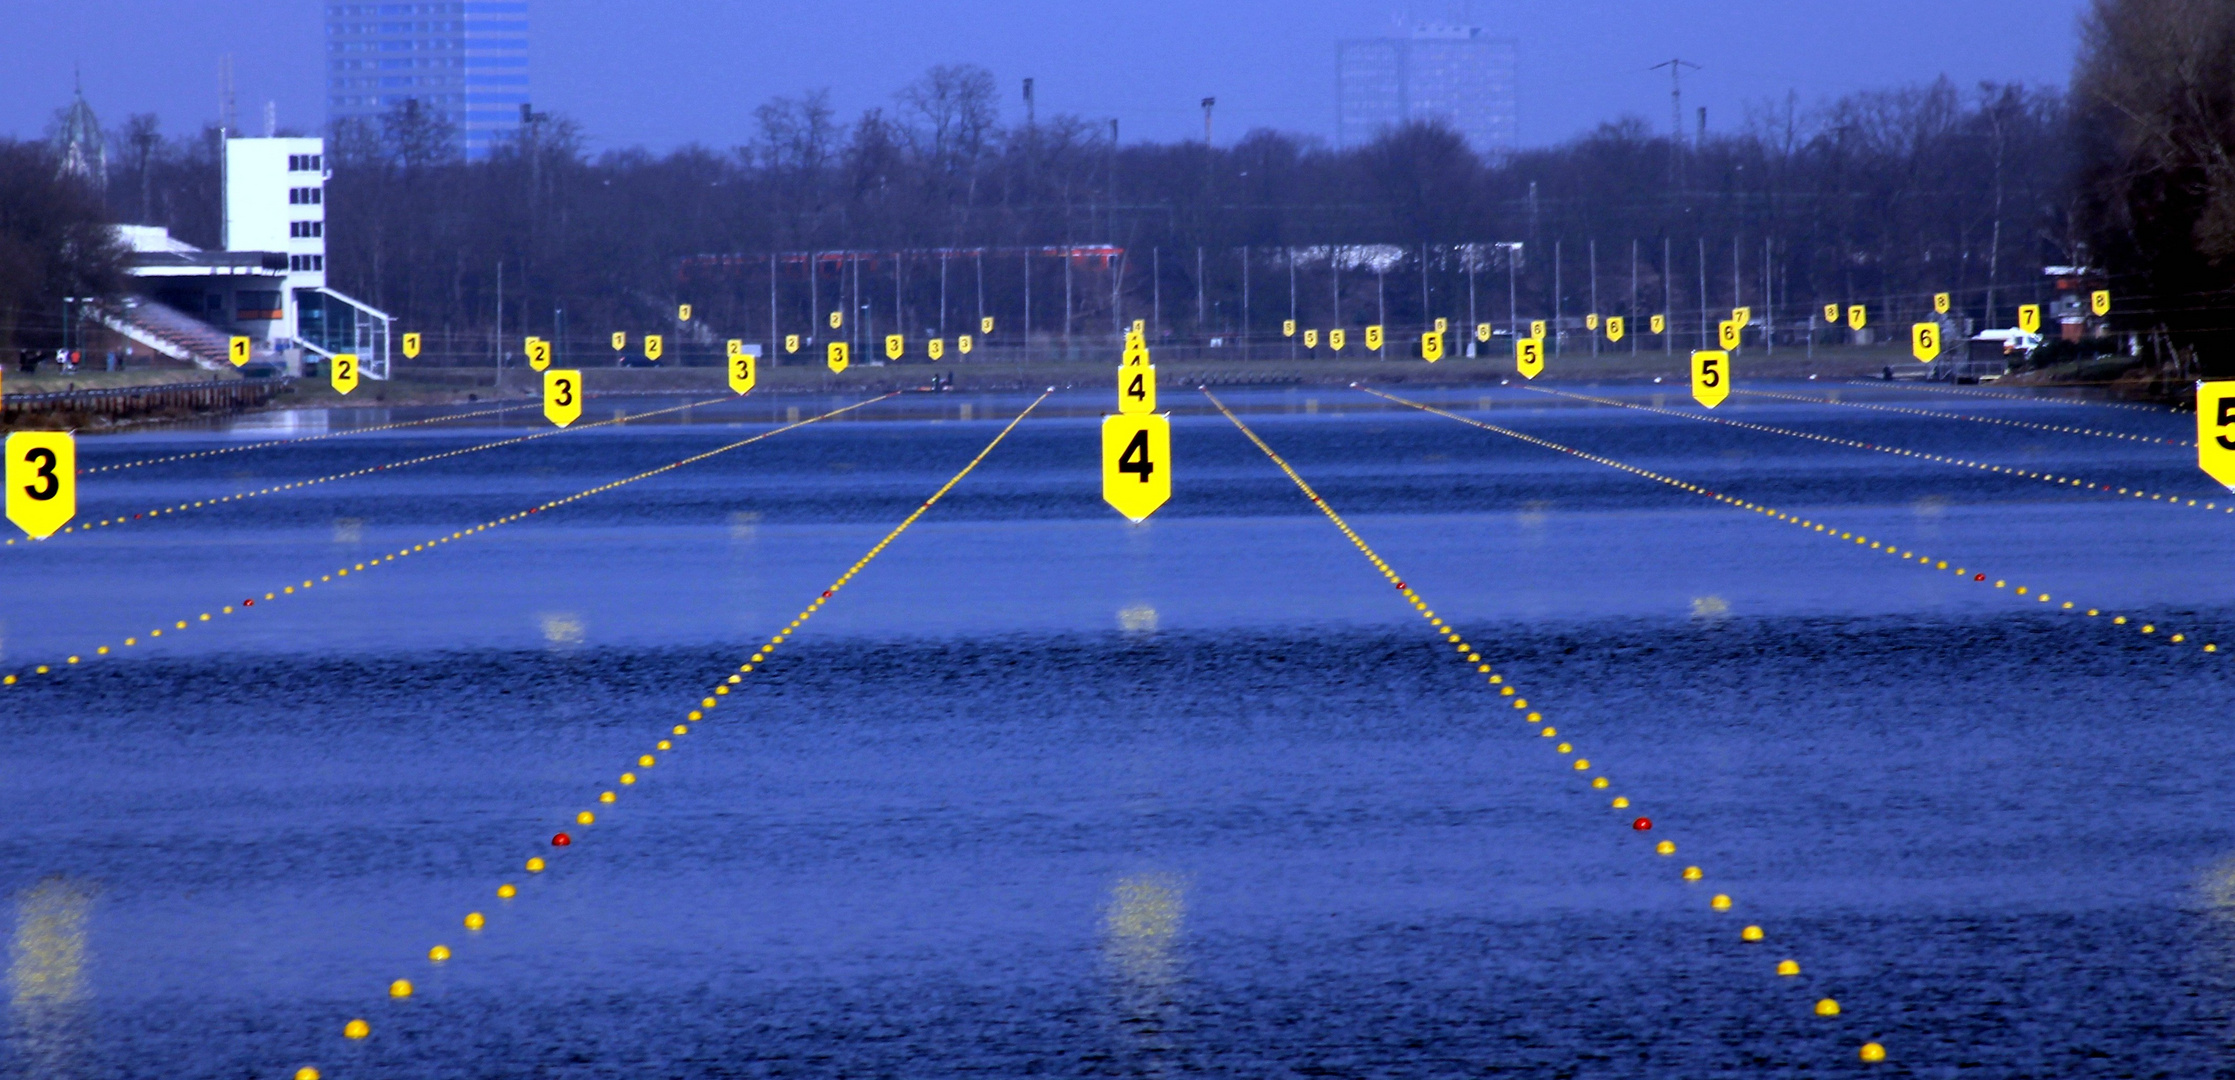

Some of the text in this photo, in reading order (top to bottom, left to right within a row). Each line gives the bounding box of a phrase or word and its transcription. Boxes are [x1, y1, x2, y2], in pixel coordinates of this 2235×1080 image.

[1938, 296, 1946, 307] 8
[2096, 294, 2105, 307] 8
[1736, 311, 1743, 322] 7
[1827, 307, 1835, 316] 8
[1852, 309, 1861, 322] 7
[2024, 309, 2034, 325] 7
[983, 319, 991, 329] 3
[1588, 317, 1595, 325] 7
[1610, 321, 1619, 333] 6
[1653, 318, 1660, 327] 7
[1370, 329, 1378, 342] 5
[1534, 324, 1542, 334] 6
[1724, 325, 1734, 340] 6
[407, 337, 416, 349] 1
[1333, 333, 1341, 344] 5
[1428, 336, 1437, 352] 5
[1920, 329, 1933, 349] 6
[235, 341, 245, 356] 1
[649, 339, 657, 352] 2
[890, 339, 899, 352] 3
[932, 342, 939, 353] 3
[535, 346, 545, 361] 2
[834, 347, 843, 362] 3
[1524, 344, 1536, 364] 5
[338, 360, 351, 380] 2
[736, 360, 748, 380] 3
[1702, 359, 1720, 388] 5
[555, 378, 572, 407] 3
[1127, 373, 1146, 402] 4
[1118, 429, 1154, 483] 4
[24, 447, 59, 501] 3
